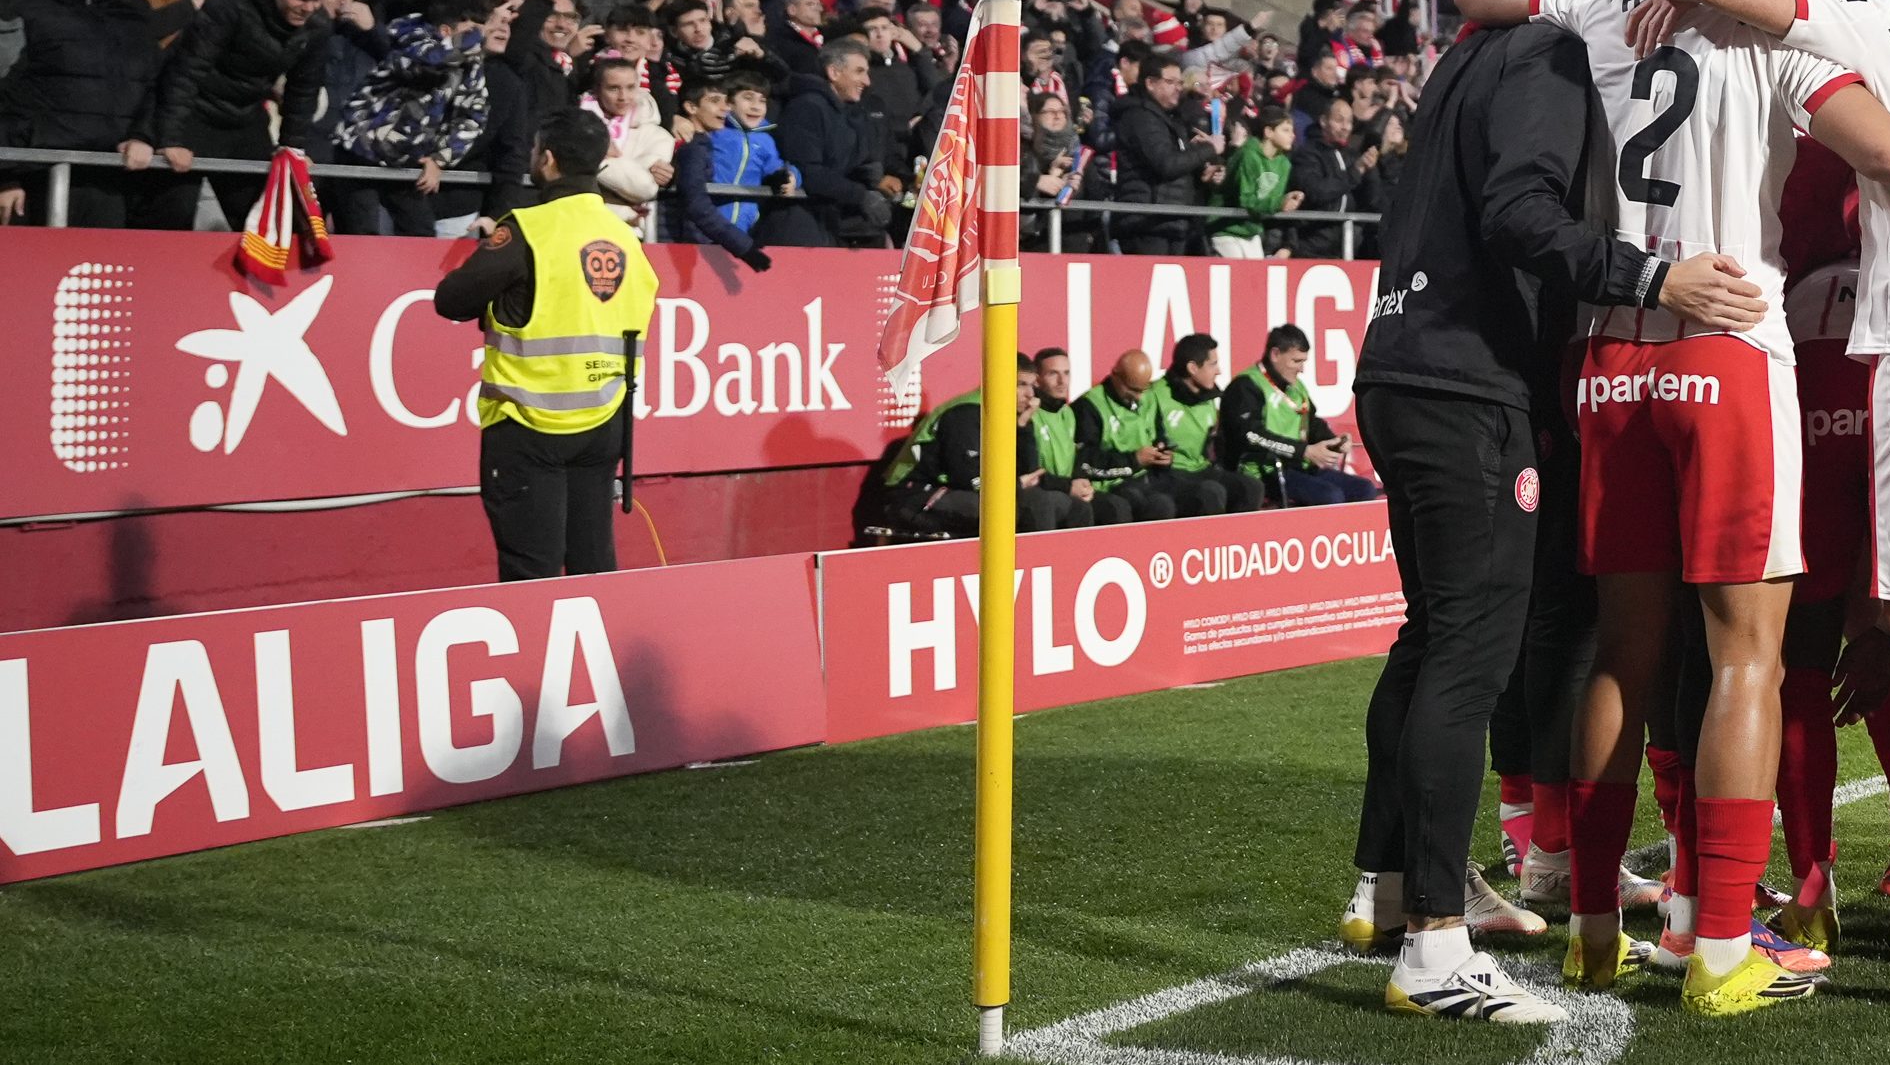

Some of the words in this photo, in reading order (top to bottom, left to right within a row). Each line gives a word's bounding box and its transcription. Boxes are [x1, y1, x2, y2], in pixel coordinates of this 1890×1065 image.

[1617, 45, 1700, 207] 2
[369, 287, 853, 429] CBank
[1066, 262, 1381, 418] LALIG
[1590, 366, 1720, 413] parlem
[1806, 408, 1869, 446] par
[1181, 538, 1305, 585] CUIDADO
[1310, 528, 1397, 570] OCULA
[0, 596, 636, 856] LALIGA
